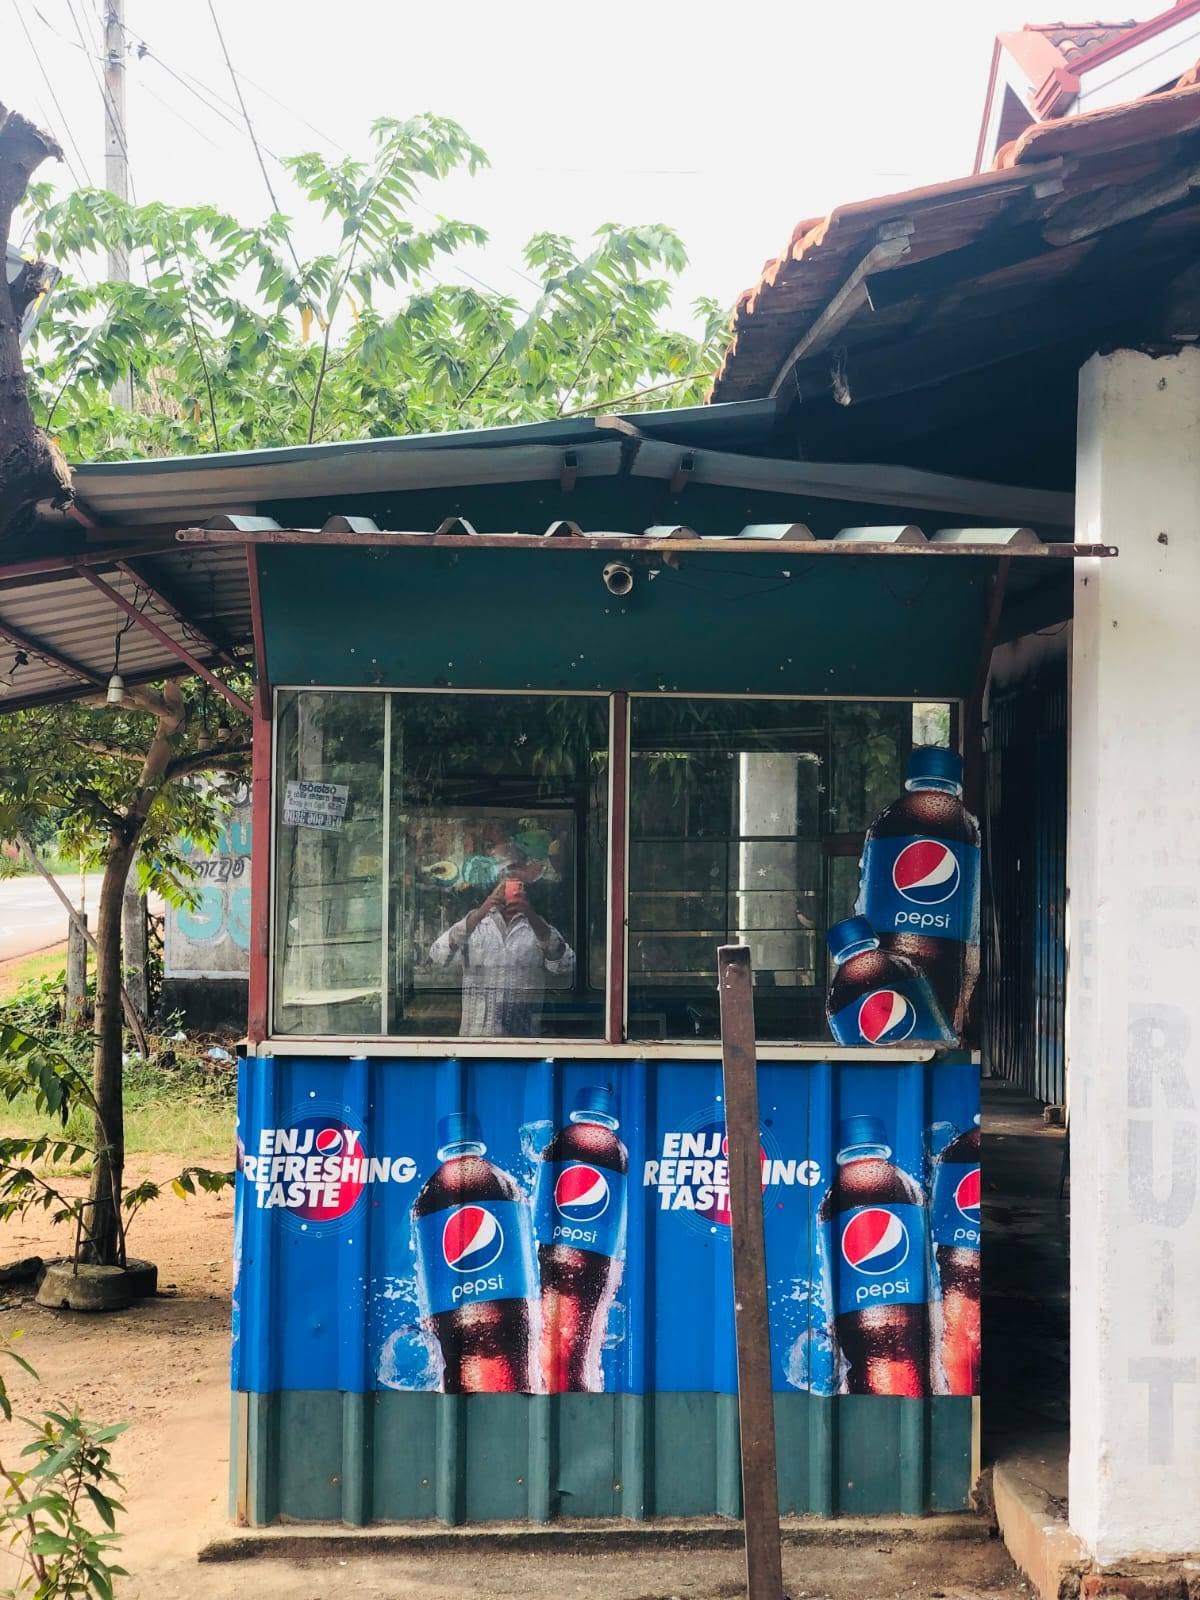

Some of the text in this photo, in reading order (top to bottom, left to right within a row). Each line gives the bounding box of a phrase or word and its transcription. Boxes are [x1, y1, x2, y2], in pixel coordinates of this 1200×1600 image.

[895, 911, 951, 929] pepsi
[259, 1128, 361, 1157] ENJOY
[663, 1132, 763, 1159] ENJ
[243, 1156, 417, 1184] REFRESHING
[643, 1159, 821, 1187] REFREING
[255, 1182, 340, 1209] TASTE
[657, 1184, 731, 1211] TAST
[553, 1225, 598, 1244] pepsi
[954, 1228, 981, 1245] pe
[452, 1274, 504, 1302] pepsi
[856, 1279, 910, 1303] pepsi
